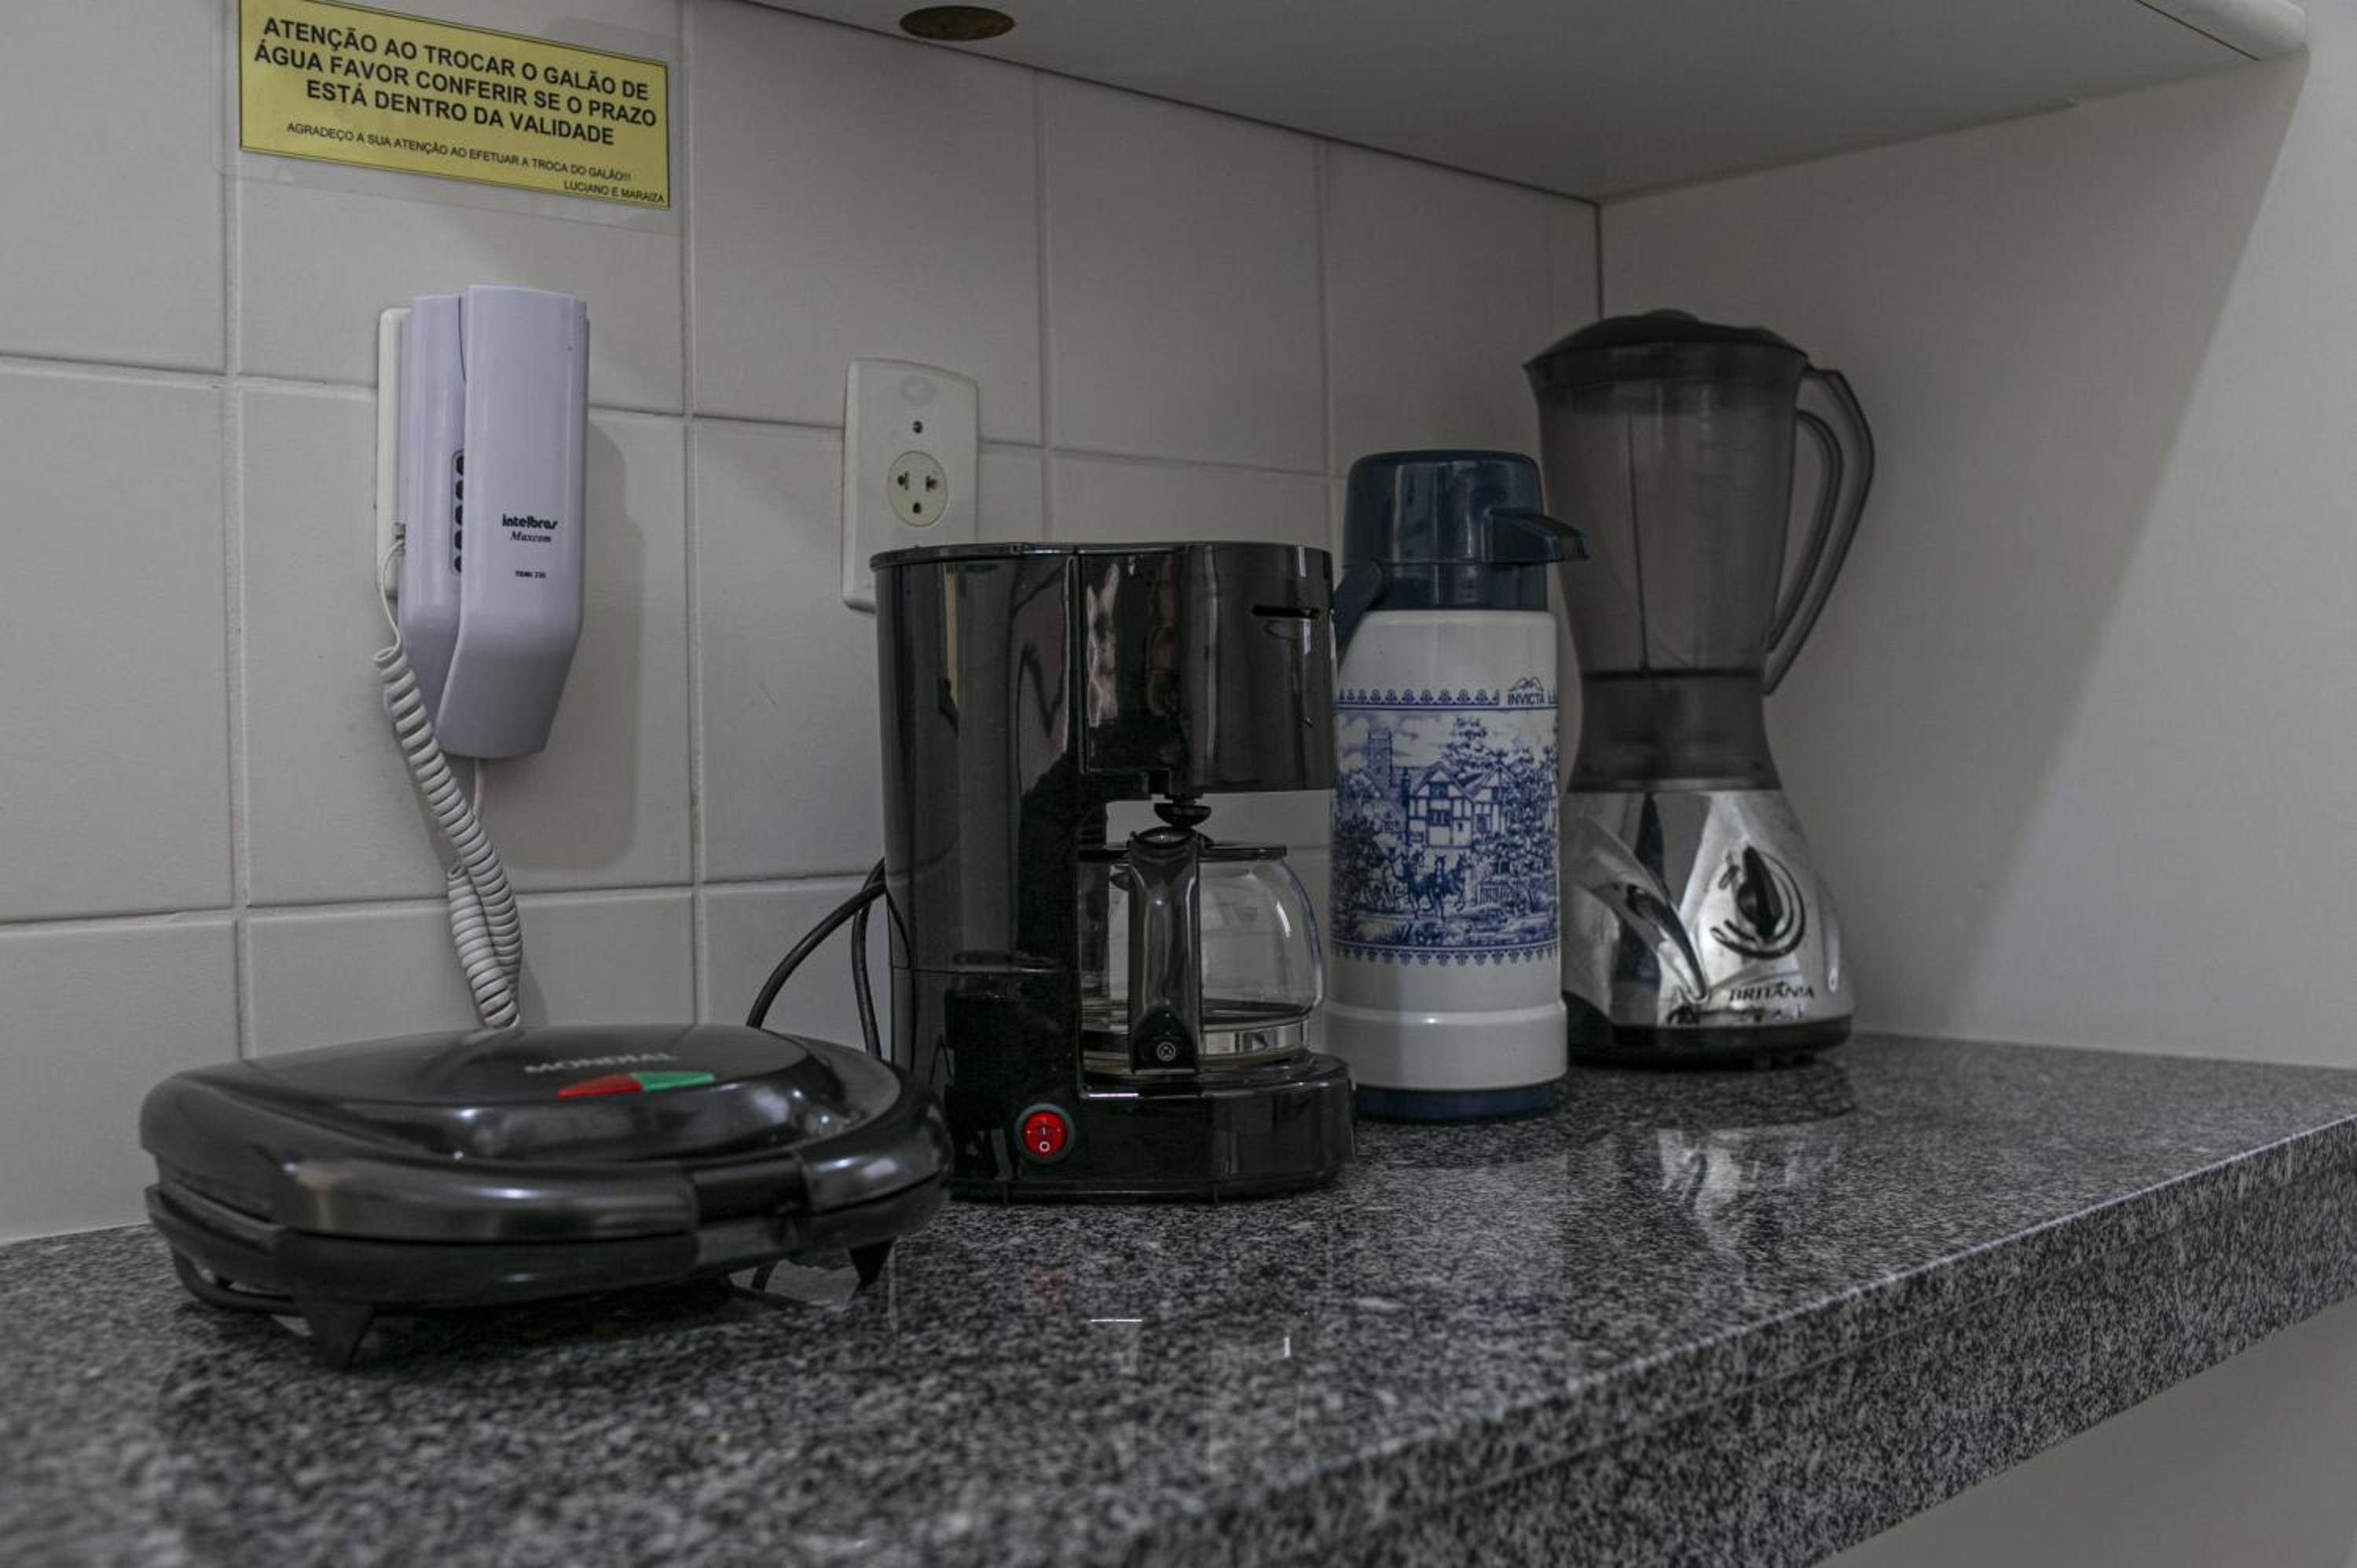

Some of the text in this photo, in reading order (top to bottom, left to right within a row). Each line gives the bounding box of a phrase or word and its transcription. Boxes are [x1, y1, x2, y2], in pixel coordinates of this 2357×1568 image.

[254, 39, 657, 127] ÁGUA FAVOR CONFERIR SE O PRAZO
[263, 16, 649, 101] ATENÇÃO AO TROCAR O GALÃO DE
[306, 79, 615, 145] ESTÁ DENTRO DA VALIDADE
[287, 122, 354, 142] AGRADEÇO
[356, 132, 365, 143] A
[367, 134, 391, 148] SUA
[394, 137, 448, 156] ATENÇÃO
[450, 146, 467, 159] AO
[470, 148, 519, 167] EFETUAR
[521, 156, 529, 167] A
[532, 158, 569, 174] TROCA
[570, 163, 586, 176] DO
[563, 180, 610, 196] LUCIANO
[611, 186, 619, 197] E
[502, 514, 559, 529] intelbras
[1508, 693, 1545, 705] INVICTA
